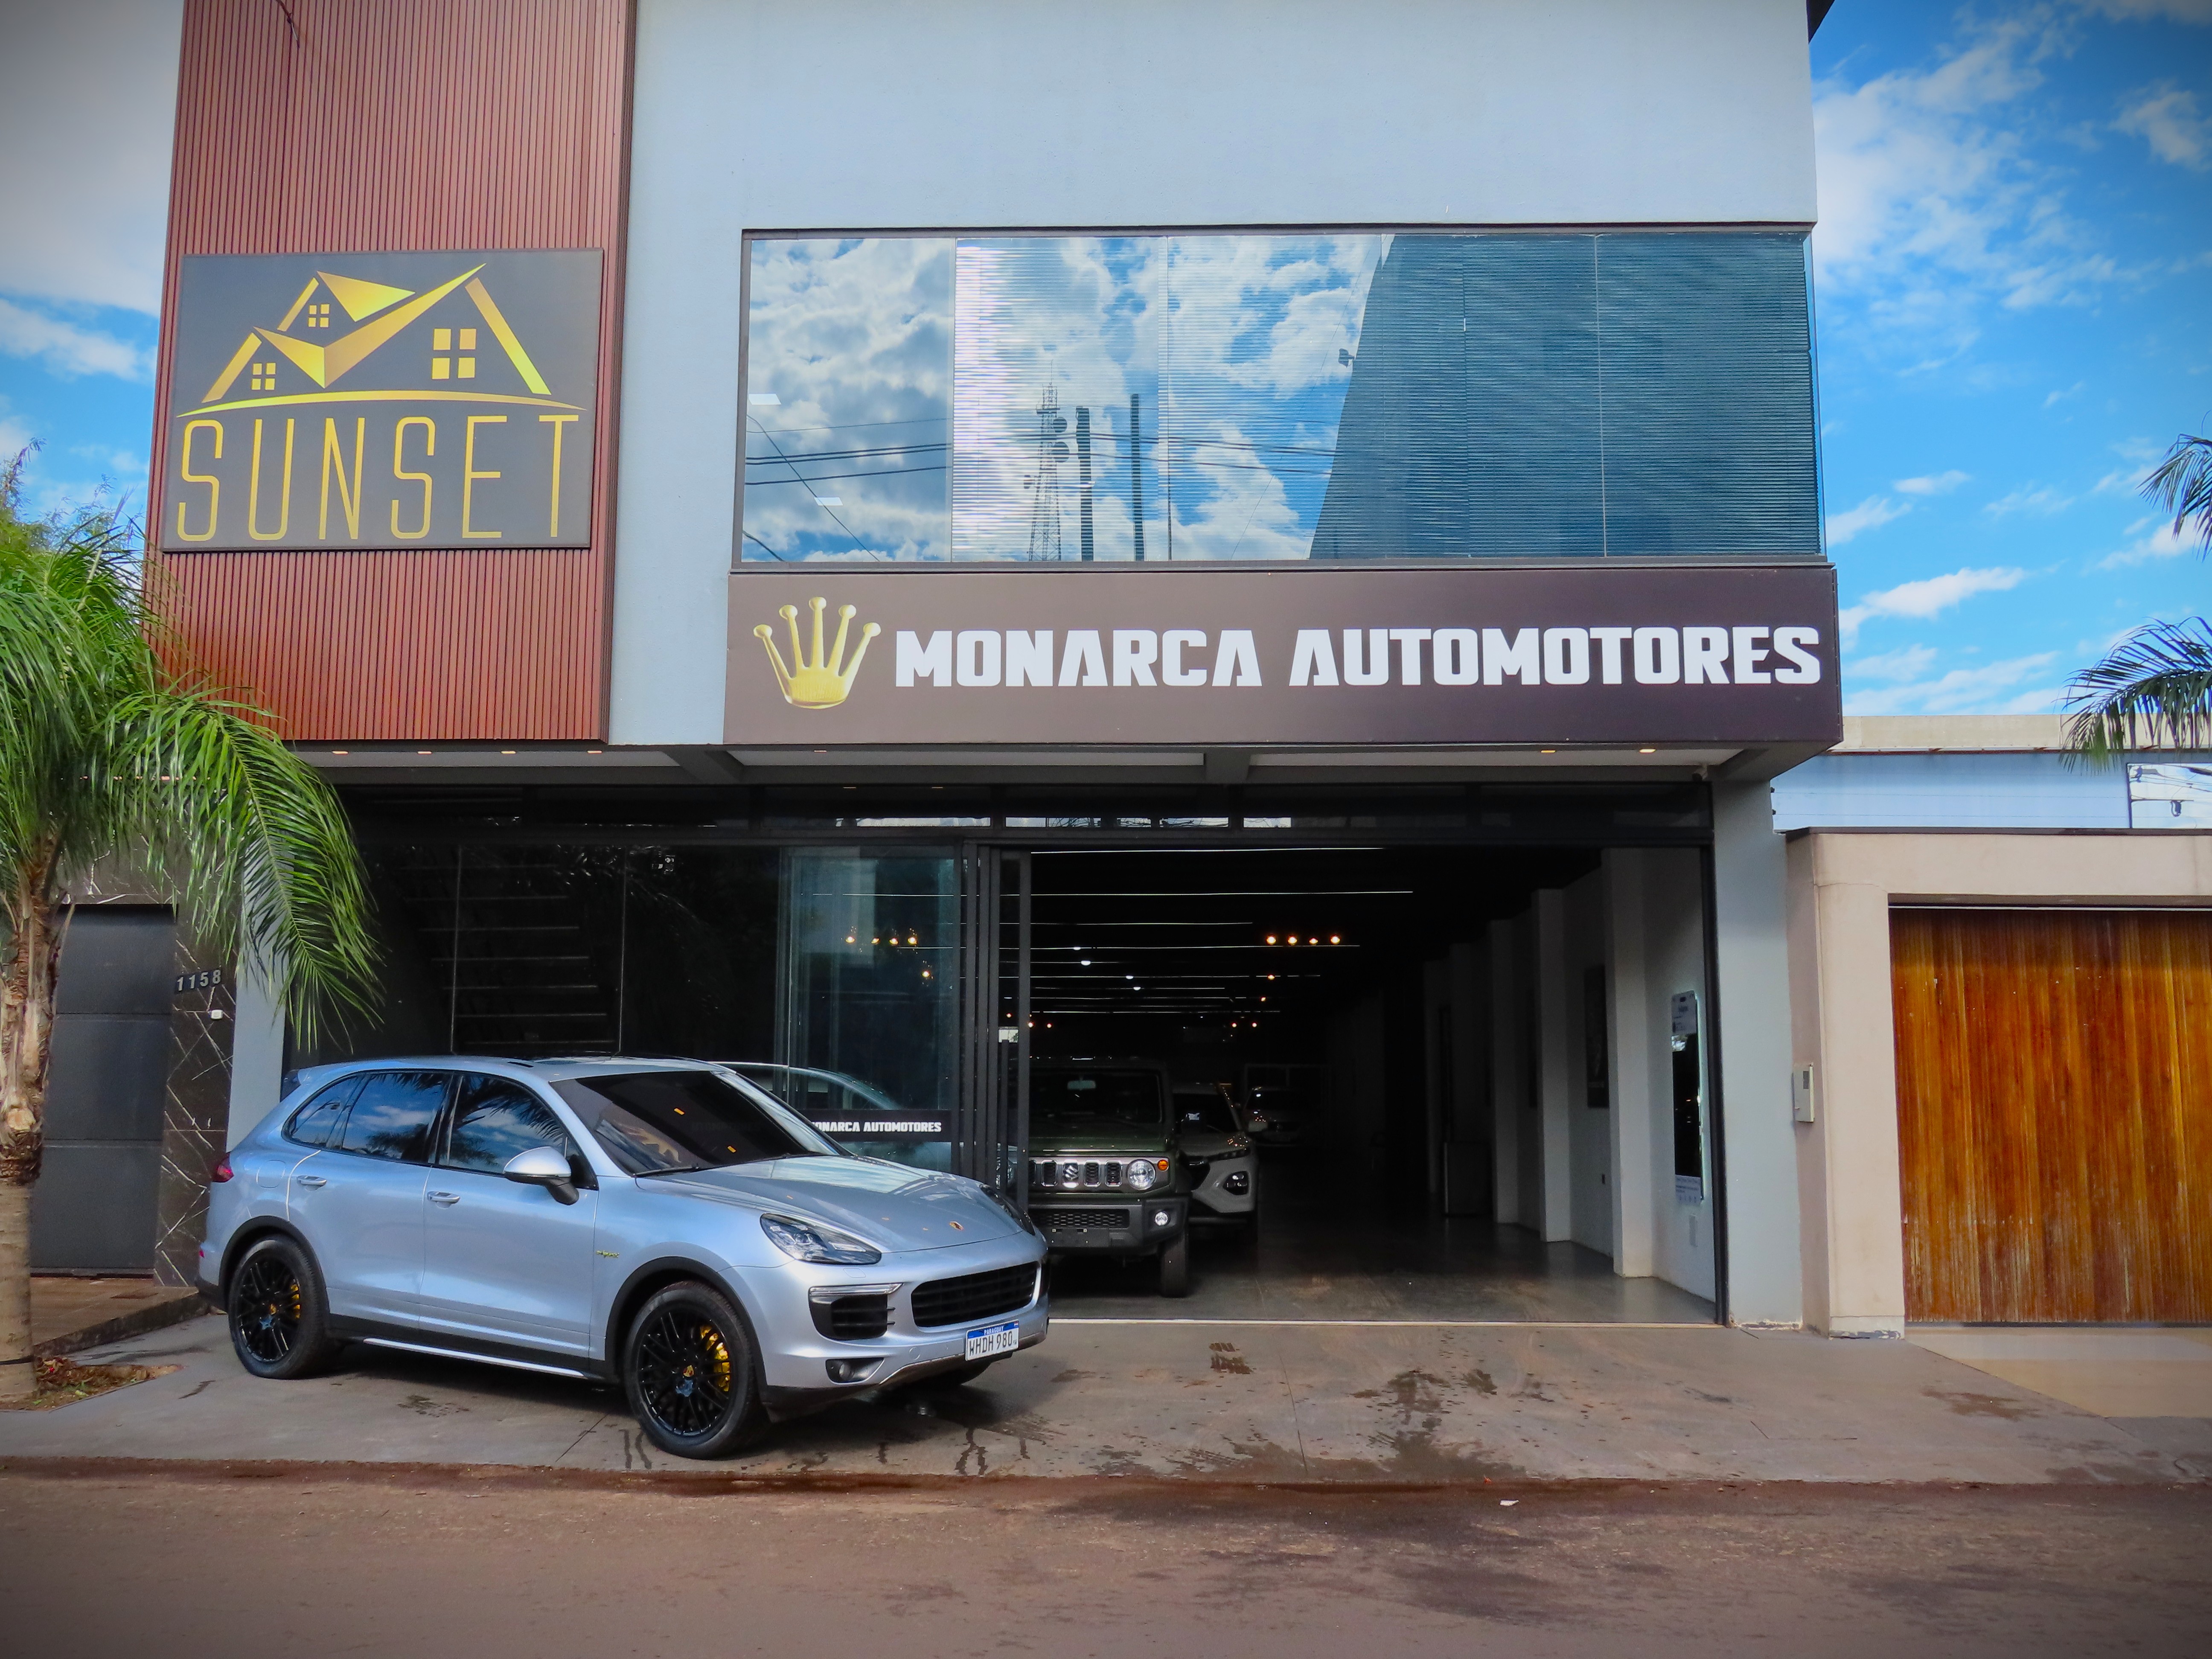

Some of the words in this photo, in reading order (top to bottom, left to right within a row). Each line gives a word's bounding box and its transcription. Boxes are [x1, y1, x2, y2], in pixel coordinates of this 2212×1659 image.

[177, 415, 579, 541] SUNSET
[896, 629, 1262, 687] MONARCA
[1289, 626, 1821, 686] AUTOMOTORES
[177, 969, 221, 991] 1158
[812, 1122, 860, 1132] ONARCA
[863, 1122, 942, 1132] AUTOMOTORES
[984, 1325, 1004, 1336] PARAGUAY
[969, 1335, 994, 1356] WHDH
[996, 1330, 1013, 1350] 980
